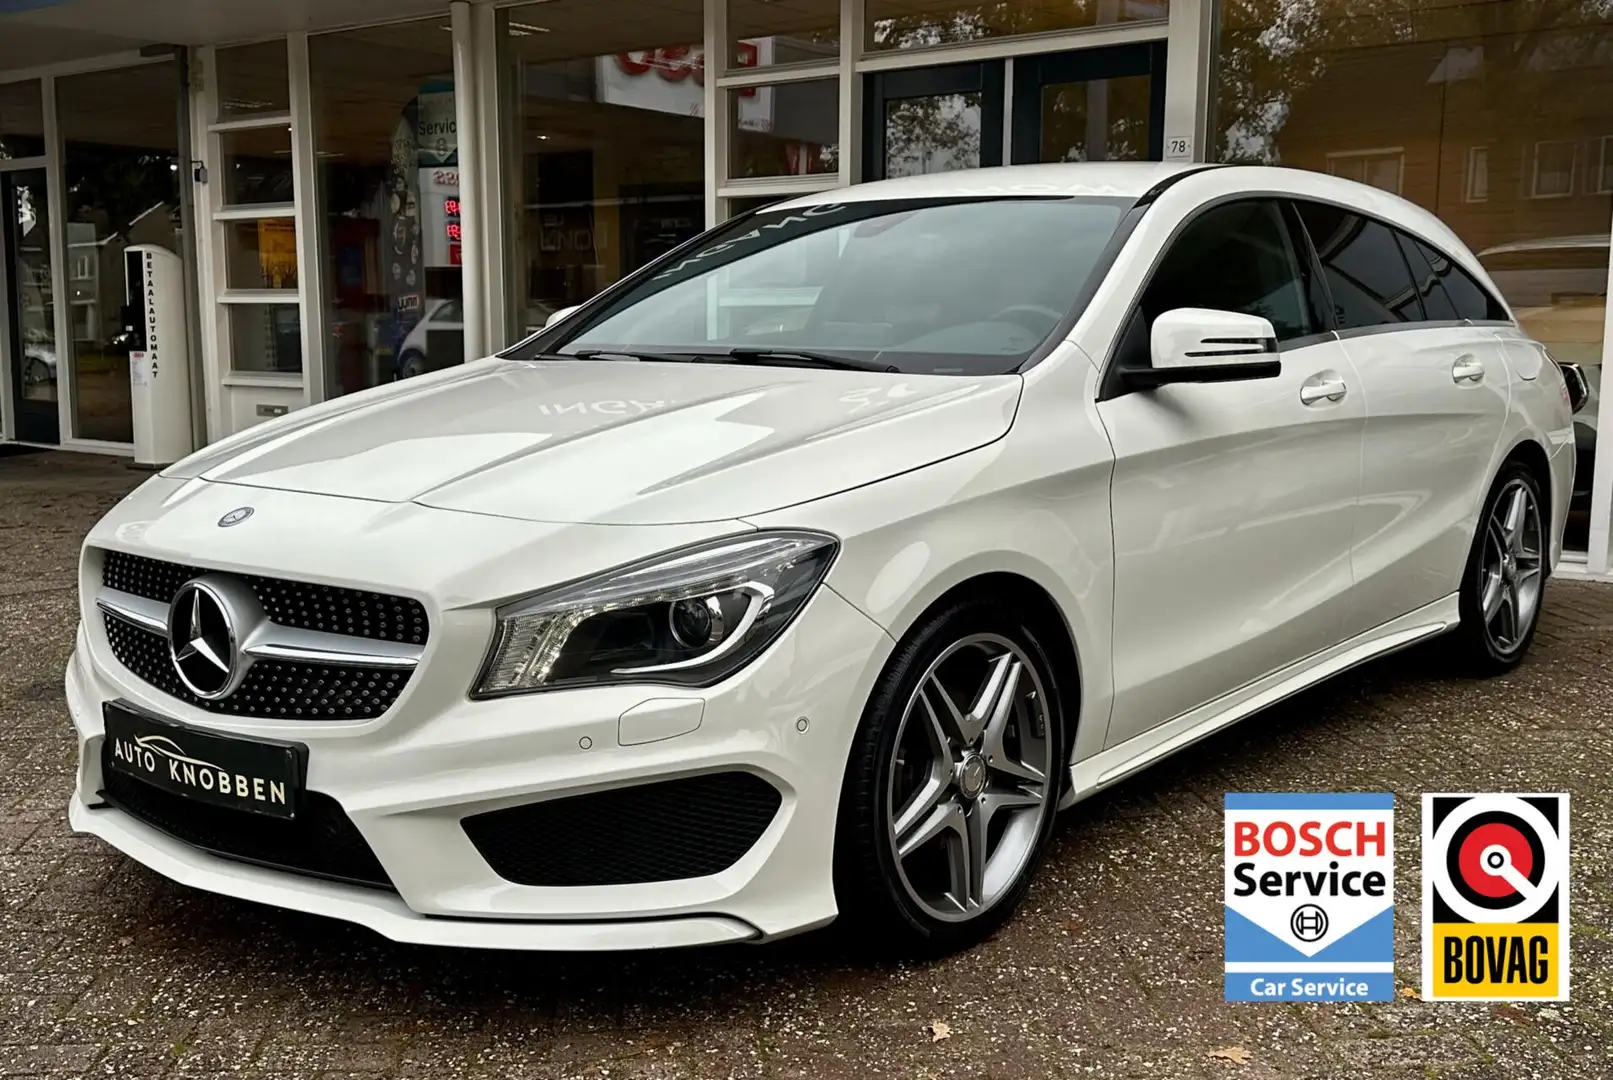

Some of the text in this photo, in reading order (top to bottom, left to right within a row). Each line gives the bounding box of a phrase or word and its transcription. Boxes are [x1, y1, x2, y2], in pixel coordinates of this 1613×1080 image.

[419, 117, 457, 135] Servic
[1171, 140, 1186, 154] 78
[146, 252, 158, 379] BETAALAUTOMAAT
[114, 737, 286, 805] AUTO KNOBBEN
